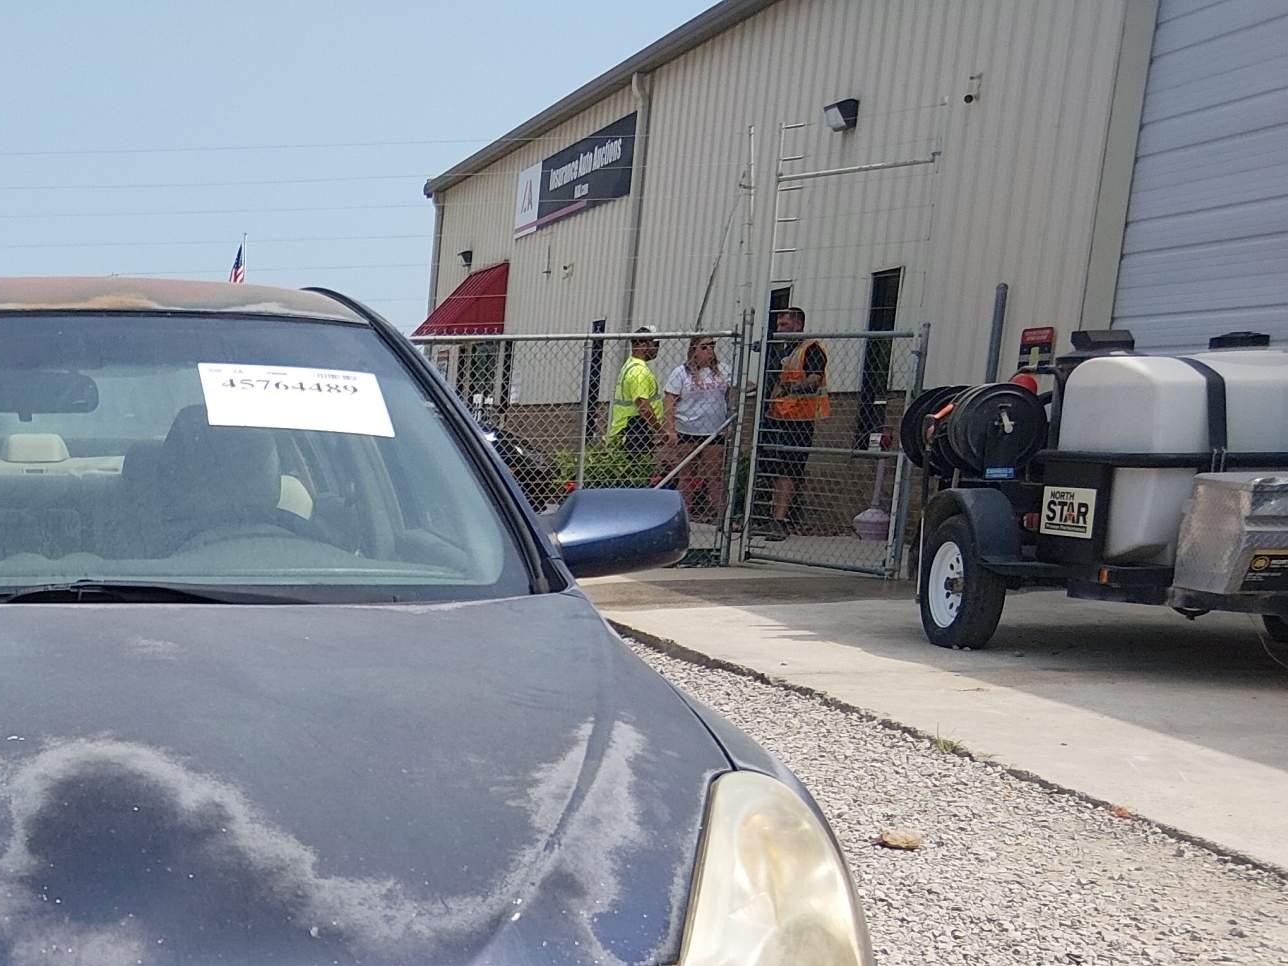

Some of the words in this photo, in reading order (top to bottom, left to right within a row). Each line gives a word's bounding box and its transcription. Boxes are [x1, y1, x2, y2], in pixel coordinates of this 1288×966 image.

[222, 378, 359, 395] 45764489
[1050, 490, 1075, 500] NORTH
[1046, 499, 1089, 525] STAR
